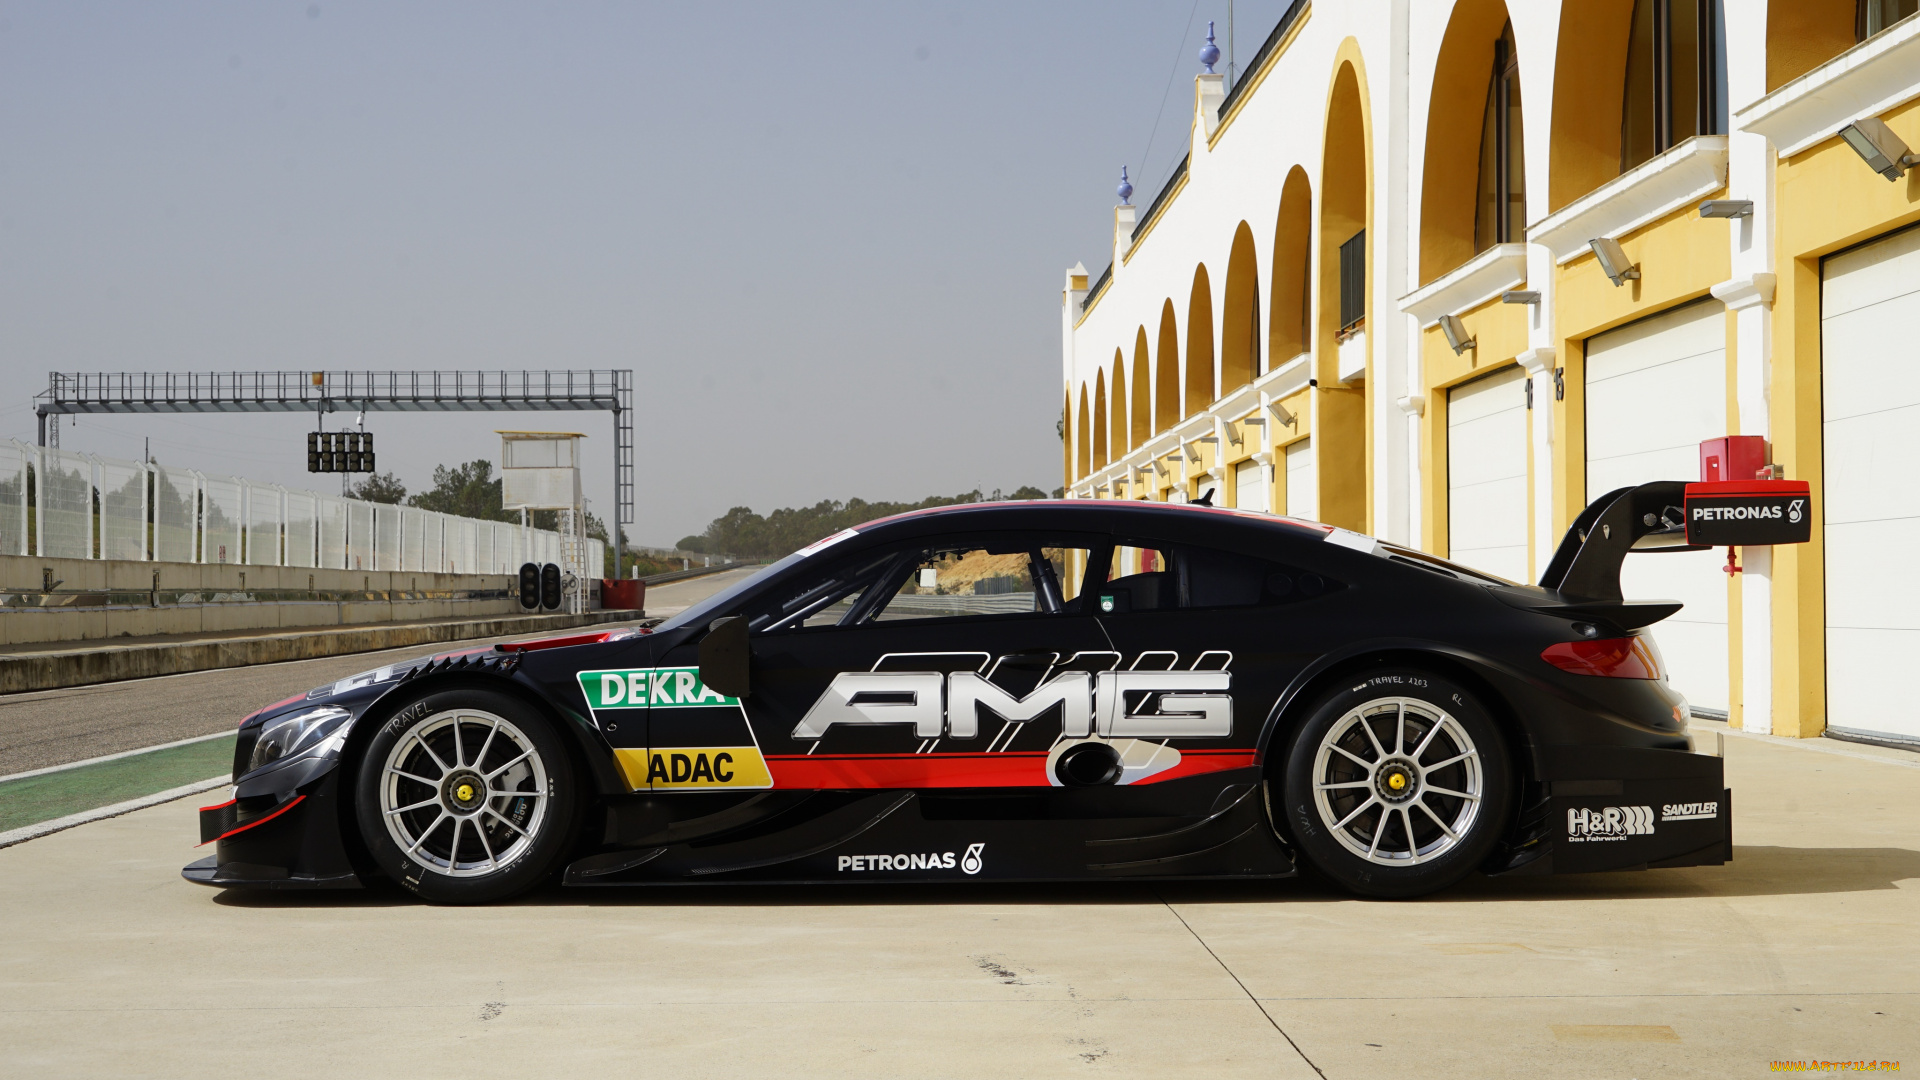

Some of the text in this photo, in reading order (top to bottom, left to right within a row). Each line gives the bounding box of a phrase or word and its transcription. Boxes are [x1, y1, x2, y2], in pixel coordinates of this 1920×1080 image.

[1554, 367, 1564, 401] 15
[1693, 506, 1782, 521] PETRONAS
[1368, 676, 1404, 686] TRAVEL
[791, 671, 1233, 740] AMG
[1452, 693, 1462, 706] RL
[385, 702, 432, 736] TRAVEL
[646, 752, 734, 783] ADAC
[1662, 802, 1718, 816] SANDTLER
[1568, 807, 1627, 837] H&R
[838, 852, 956, 872] PETRONAS
